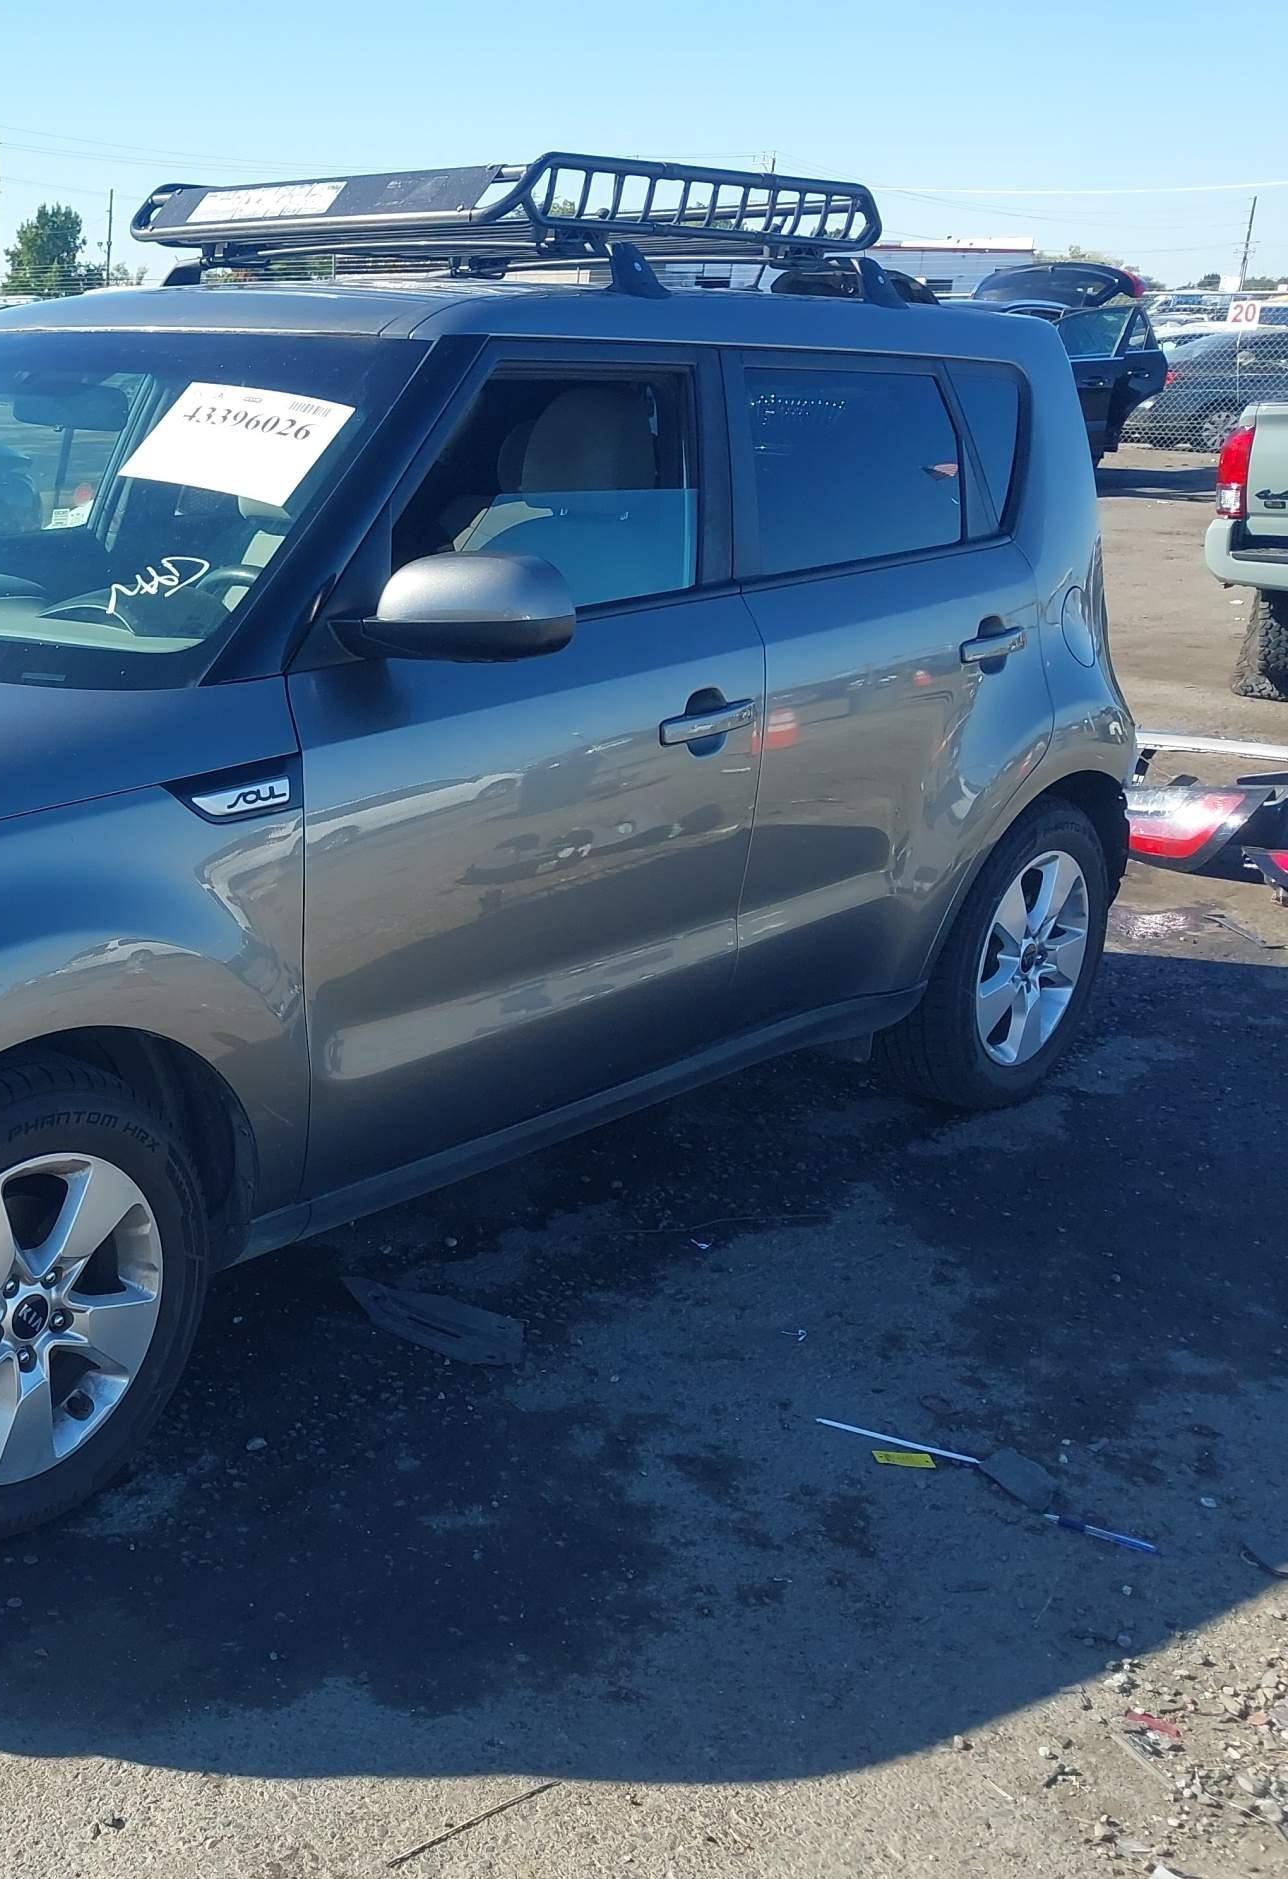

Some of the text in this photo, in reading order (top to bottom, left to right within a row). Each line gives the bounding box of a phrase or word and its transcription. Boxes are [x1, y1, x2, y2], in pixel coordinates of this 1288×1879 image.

[1231, 303, 1257, 323] 20
[184, 405, 317, 441] 43396026
[227, 786, 287, 809] SOUL
[8, 1111, 161, 1152] PHANTOM HRX
[18, 1303, 43, 1332] KIA
